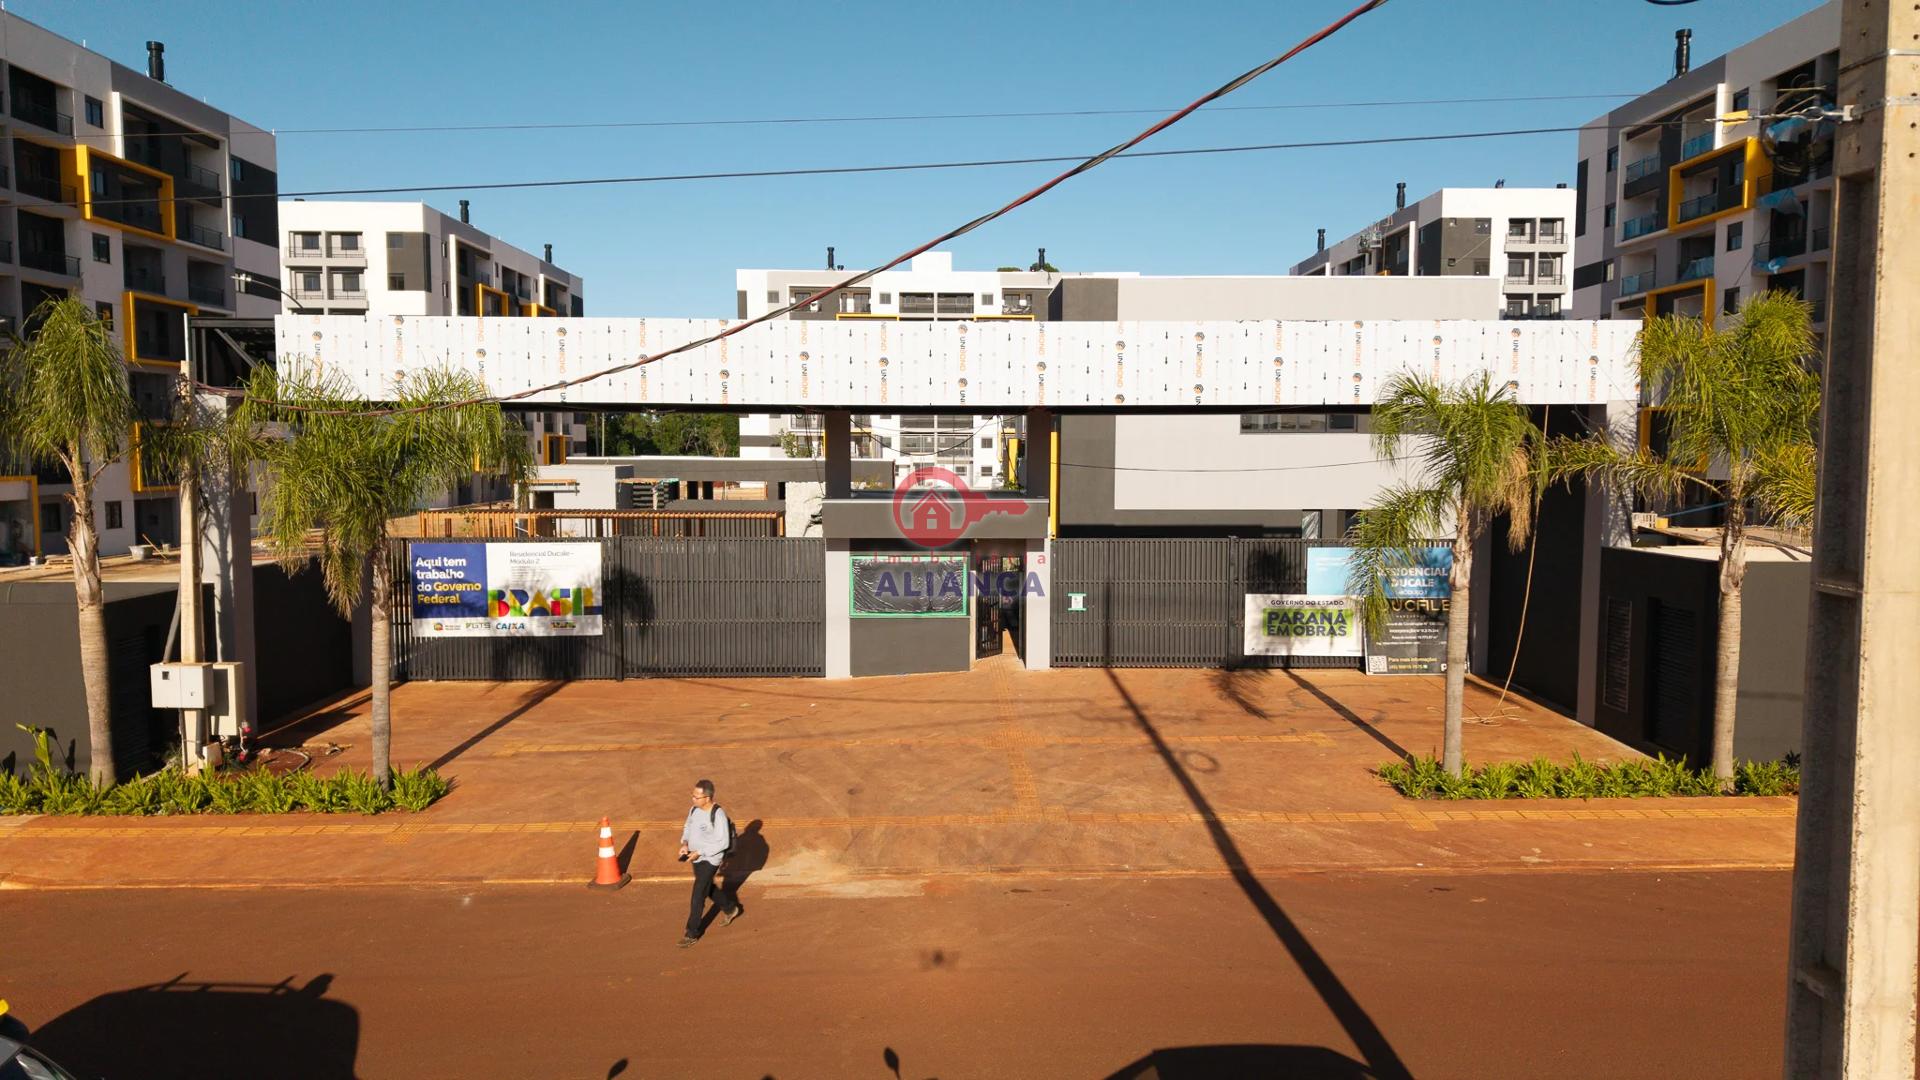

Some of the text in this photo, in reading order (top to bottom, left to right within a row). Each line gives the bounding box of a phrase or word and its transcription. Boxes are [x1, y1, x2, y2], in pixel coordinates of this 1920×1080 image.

[415, 558, 467, 569] Aqui tem
[415, 570, 465, 579] trabalho
[417, 581, 482, 591] do Governo
[417, 593, 461, 604] Federal
[488, 588, 602, 617] BRASIL
[1391, 599, 1450, 612] UCALE
[1267, 609, 1347, 625] PARANÁ
[495, 622, 526, 631] CAIXA
[1267, 625, 1347, 636] EM OBRAS
